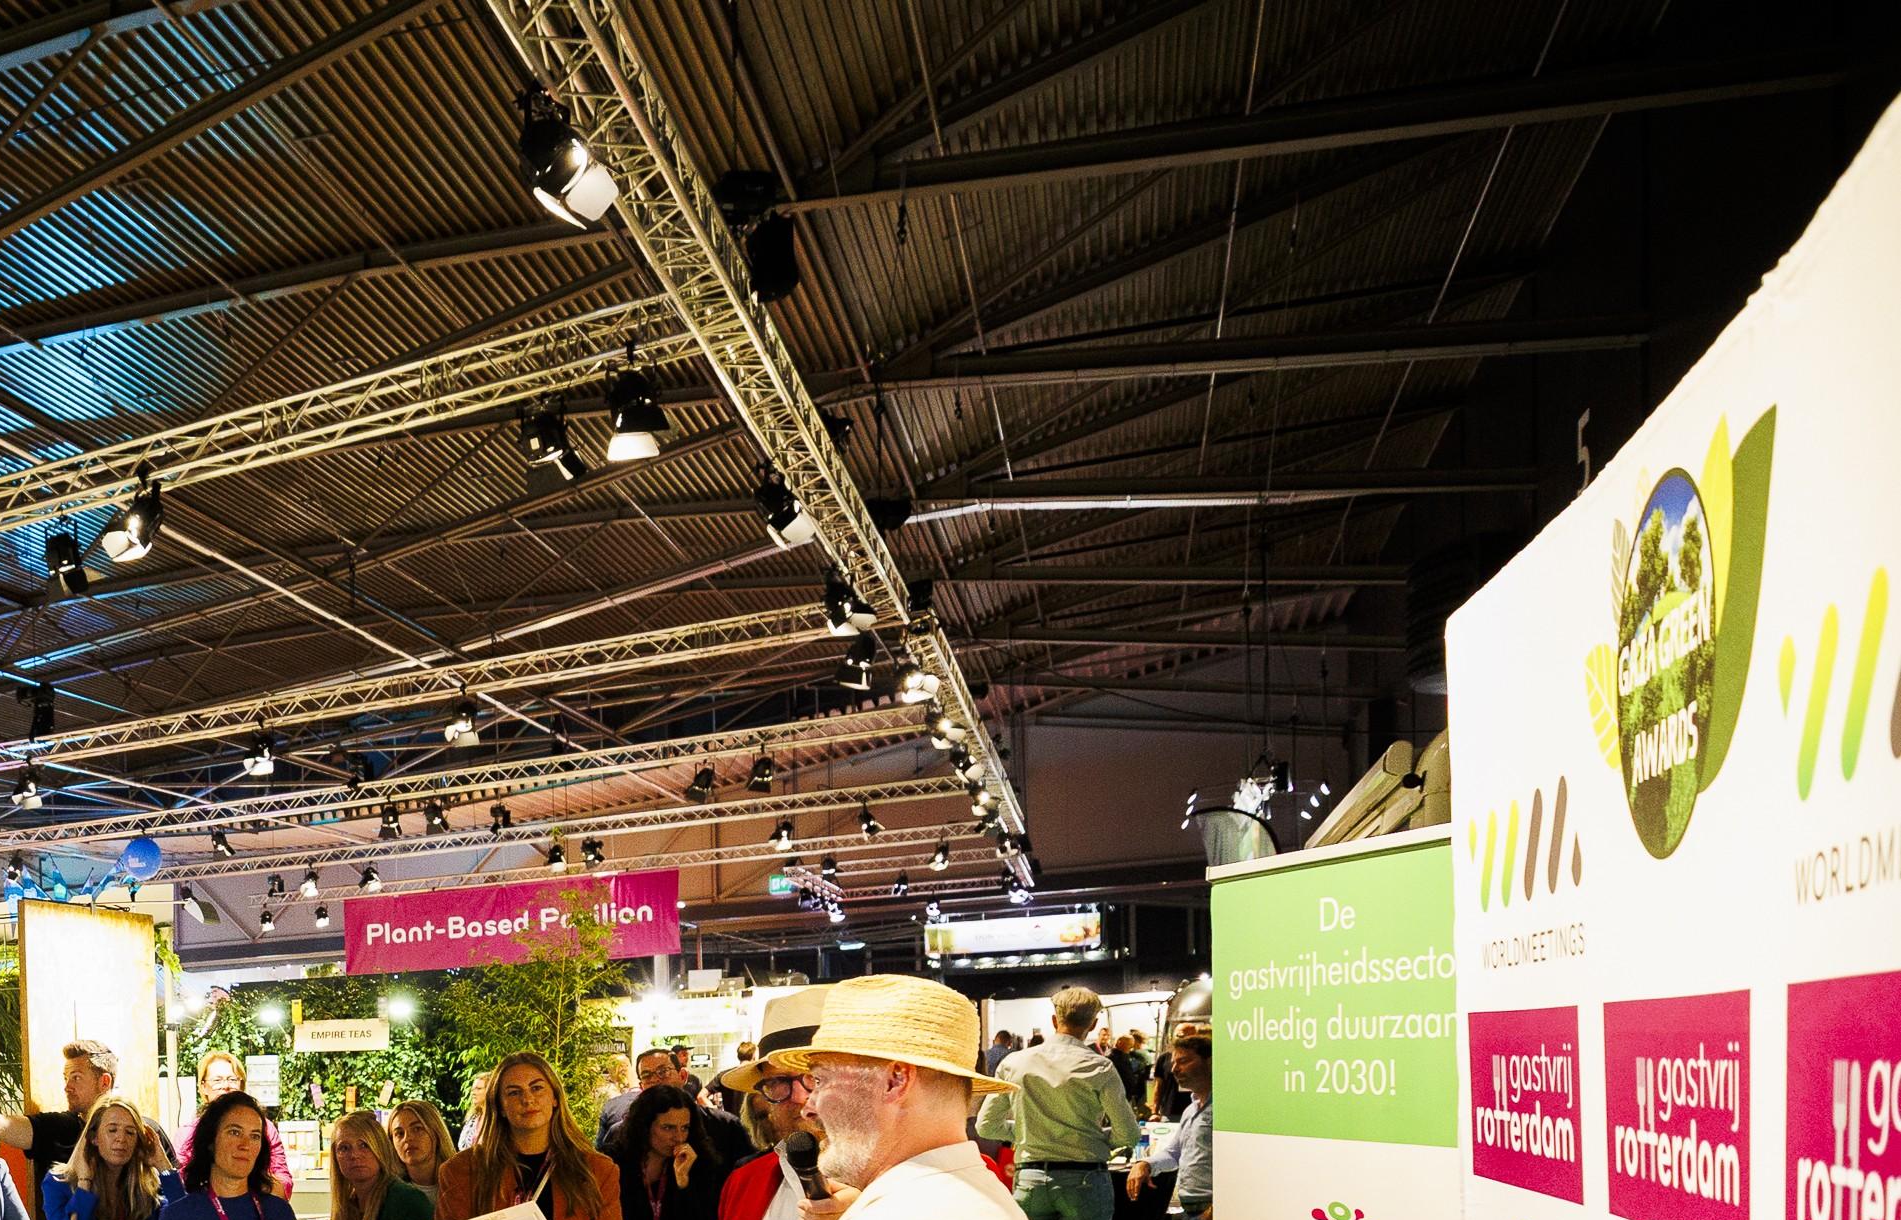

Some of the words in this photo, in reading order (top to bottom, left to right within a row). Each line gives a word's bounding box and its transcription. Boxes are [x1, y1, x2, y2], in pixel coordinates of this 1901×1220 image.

[1658, 584, 1712, 672] GREEN
[1632, 700, 1699, 788] AWARDS
[1795, 824, 1901, 905] WORLDM
[365, 909, 530, 946] Plant-Based
[540, 902, 653, 932] Pailion
[1318, 896, 1356, 932] De
[1229, 945, 1457, 1001] gastvrijheidssecto
[1481, 922, 1586, 970] WORLDMEETINGS
[310, 1030, 346, 1041] EMPIRE
[348, 1029, 373, 1039] TEAS
[1226, 1005, 1318, 1050] volledig
[1283, 1059, 1306, 1092] in
[1315, 1057, 1397, 1096] 2030!
[1509, 1042, 1573, 1109] gastvrij
[1657, 1041, 1740, 1133] gastvrij
[1476, 1100, 1575, 1163] rotterdam
[1614, 1118, 1740, 1207] rotterdam
